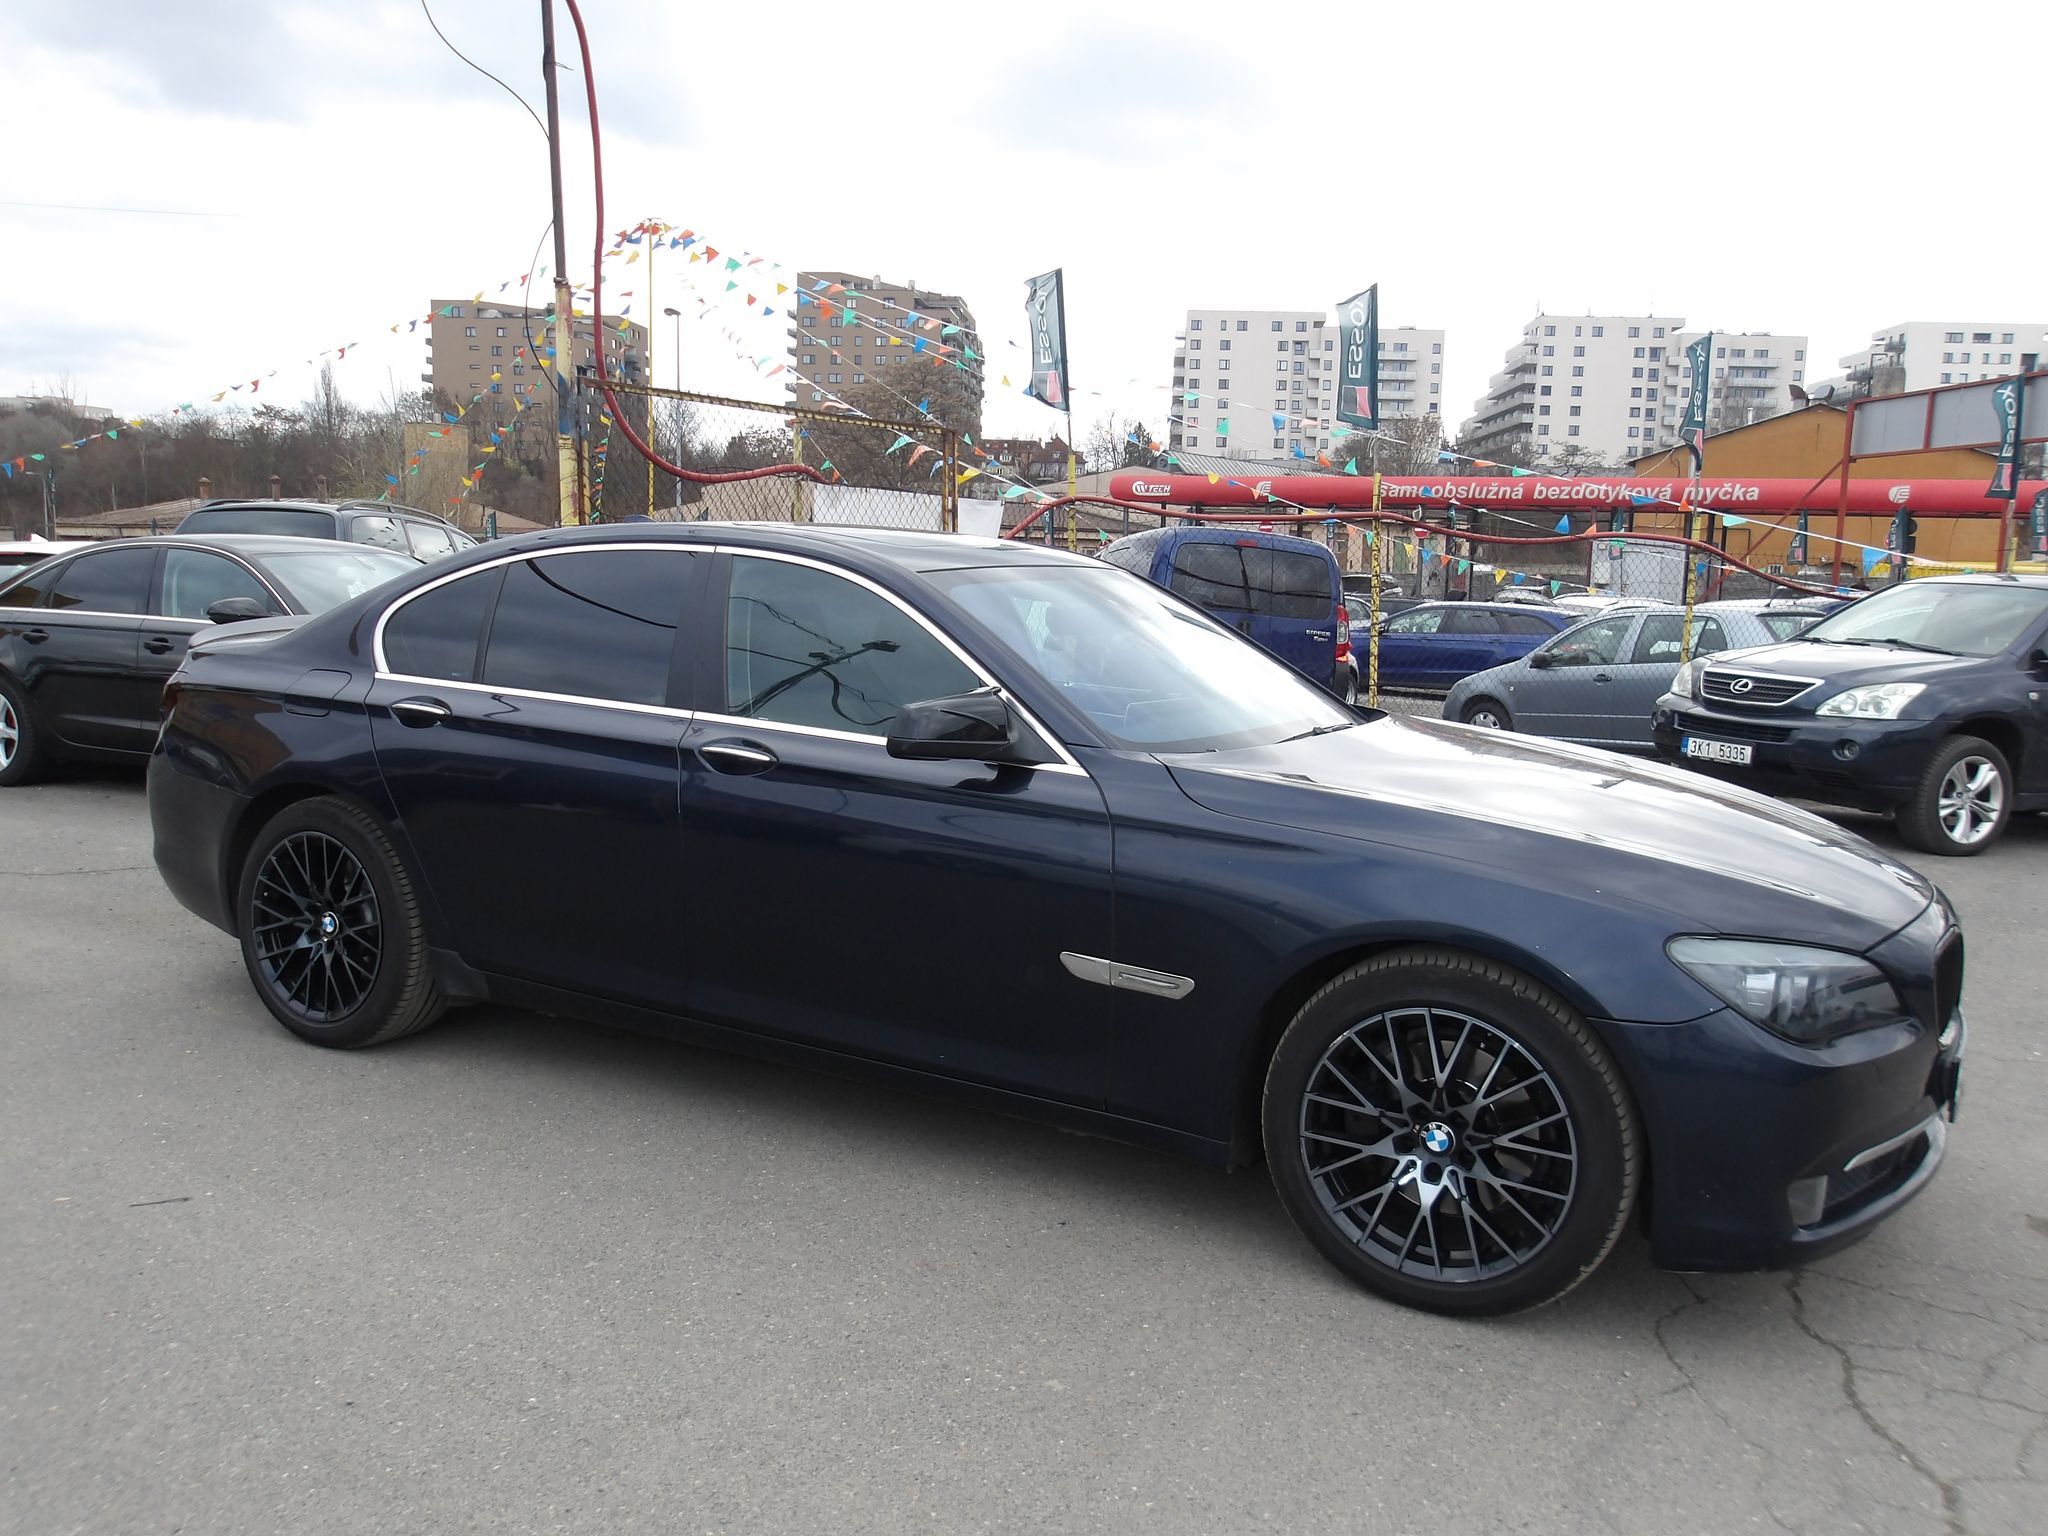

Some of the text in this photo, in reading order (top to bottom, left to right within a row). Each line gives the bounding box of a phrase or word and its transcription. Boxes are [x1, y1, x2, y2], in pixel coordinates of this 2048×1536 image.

[1533, 482, 1673, 503] bezdotyková
[1682, 482, 1760, 505] myčka
[1690, 740, 1711, 755] 3K1
[1718, 744, 1746, 761] 5335
